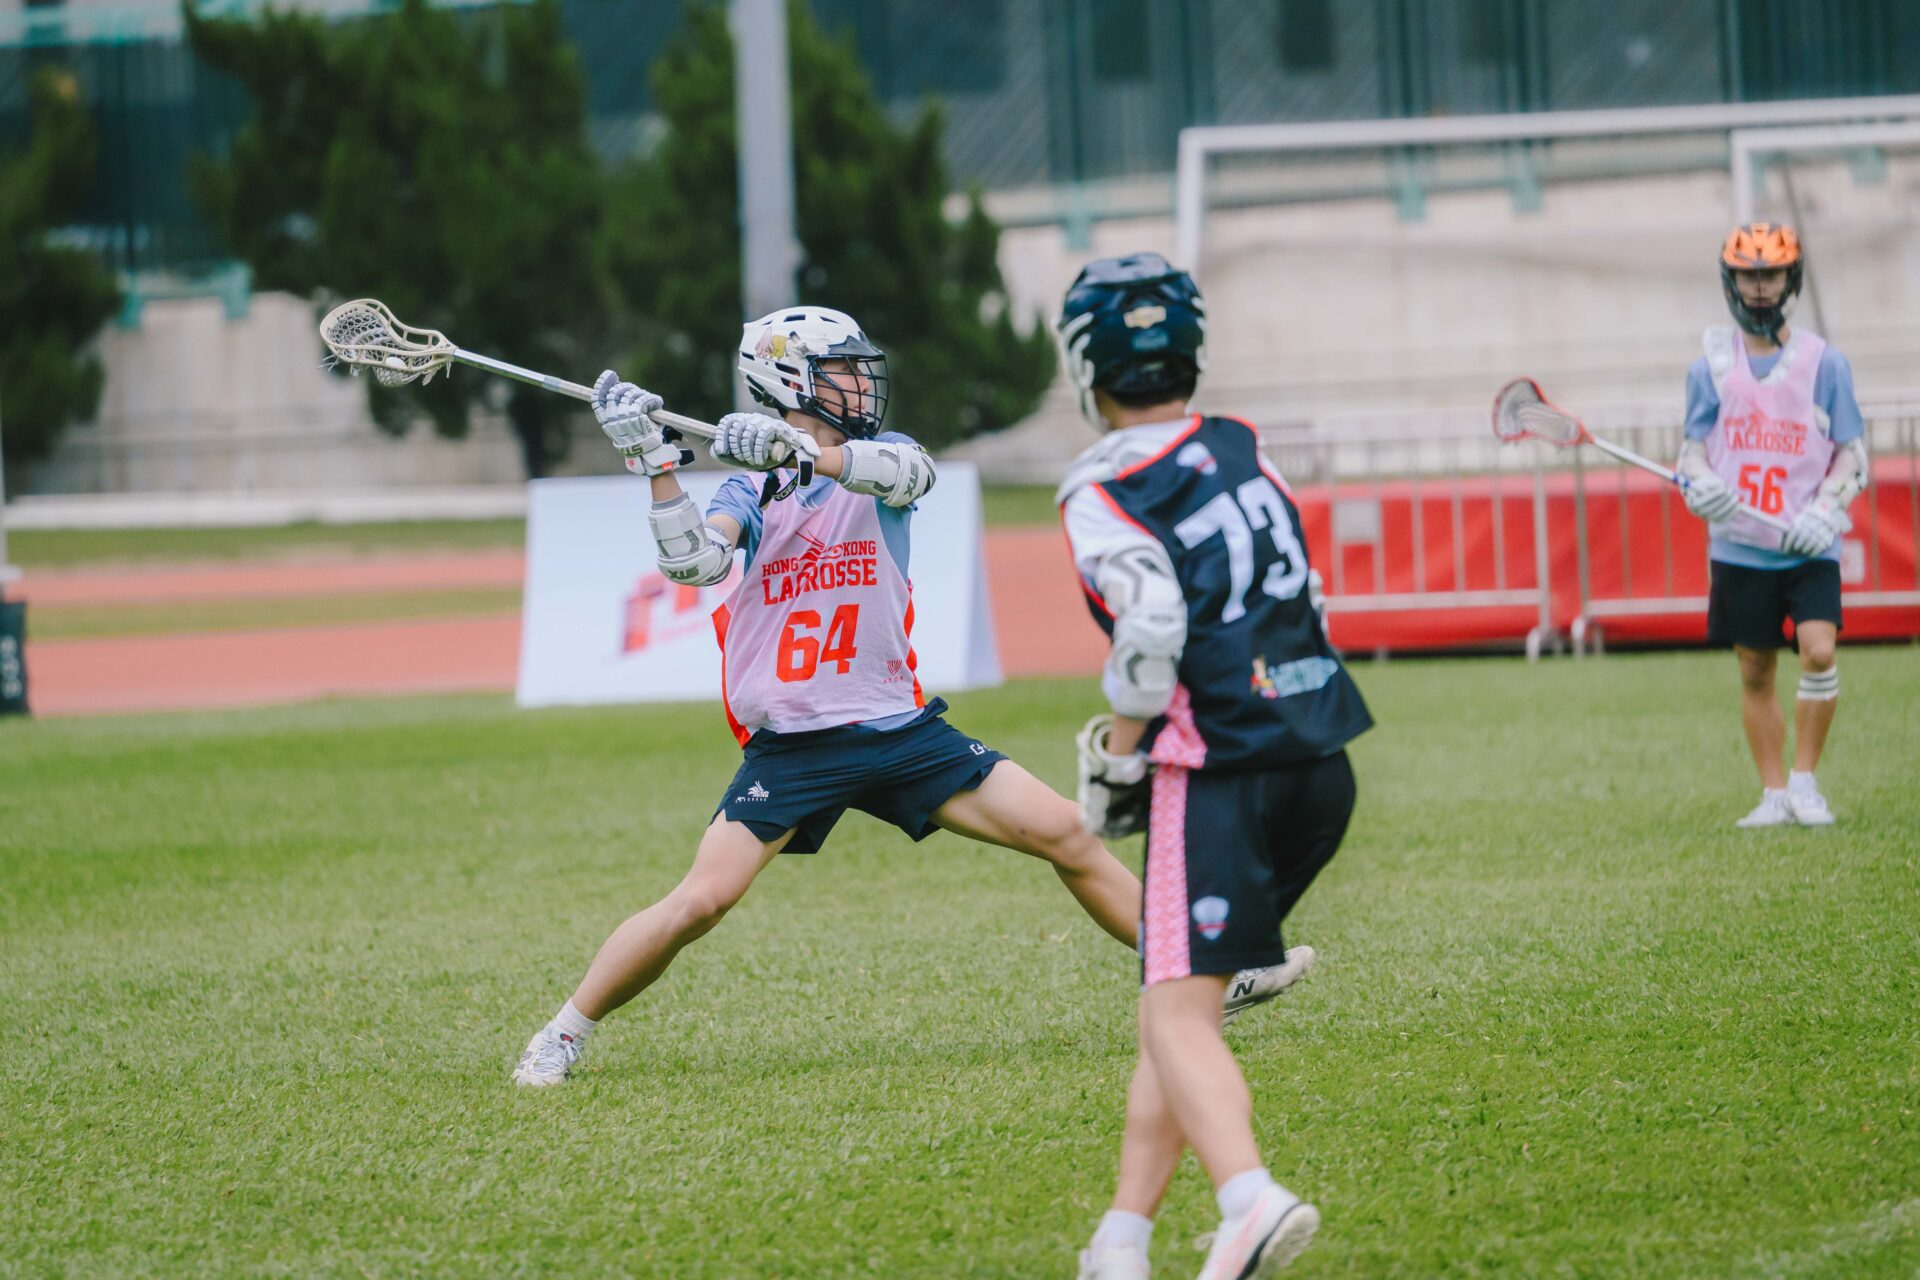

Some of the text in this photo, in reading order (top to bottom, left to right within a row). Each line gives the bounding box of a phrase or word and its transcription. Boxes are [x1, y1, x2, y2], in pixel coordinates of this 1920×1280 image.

[1738, 464, 1787, 516] 56
[762, 540, 877, 577] HONG KONG
[1174, 476, 1308, 623] 73
[776, 604, 860, 683] 64
[1232, 979, 1256, 998] N
